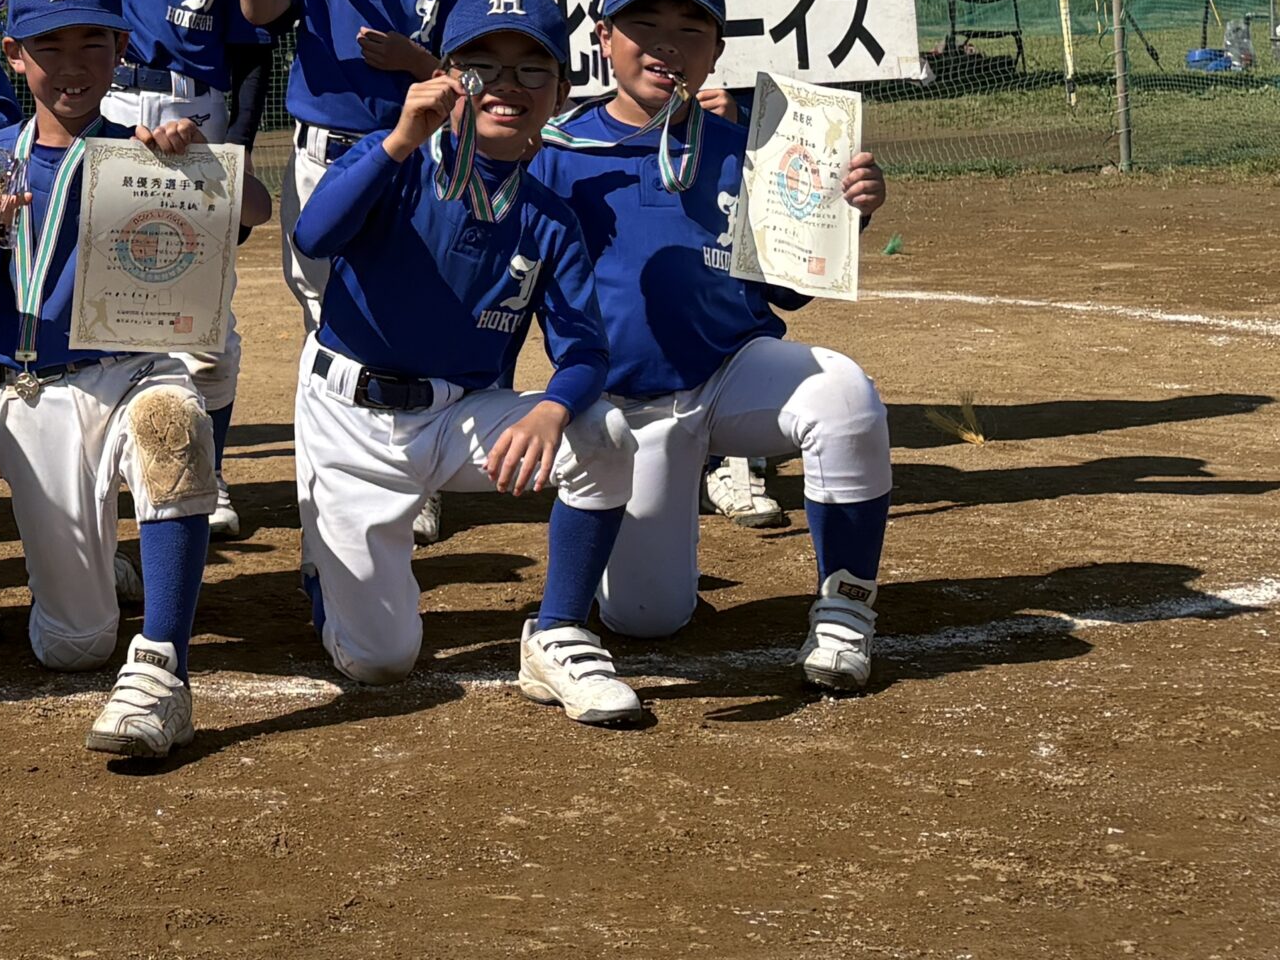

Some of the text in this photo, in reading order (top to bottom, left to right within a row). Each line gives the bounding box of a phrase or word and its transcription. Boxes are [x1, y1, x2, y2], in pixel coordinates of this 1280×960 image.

[122, 176, 205, 191] 最優秀選手賞
[135, 649, 169, 668] ZETT
